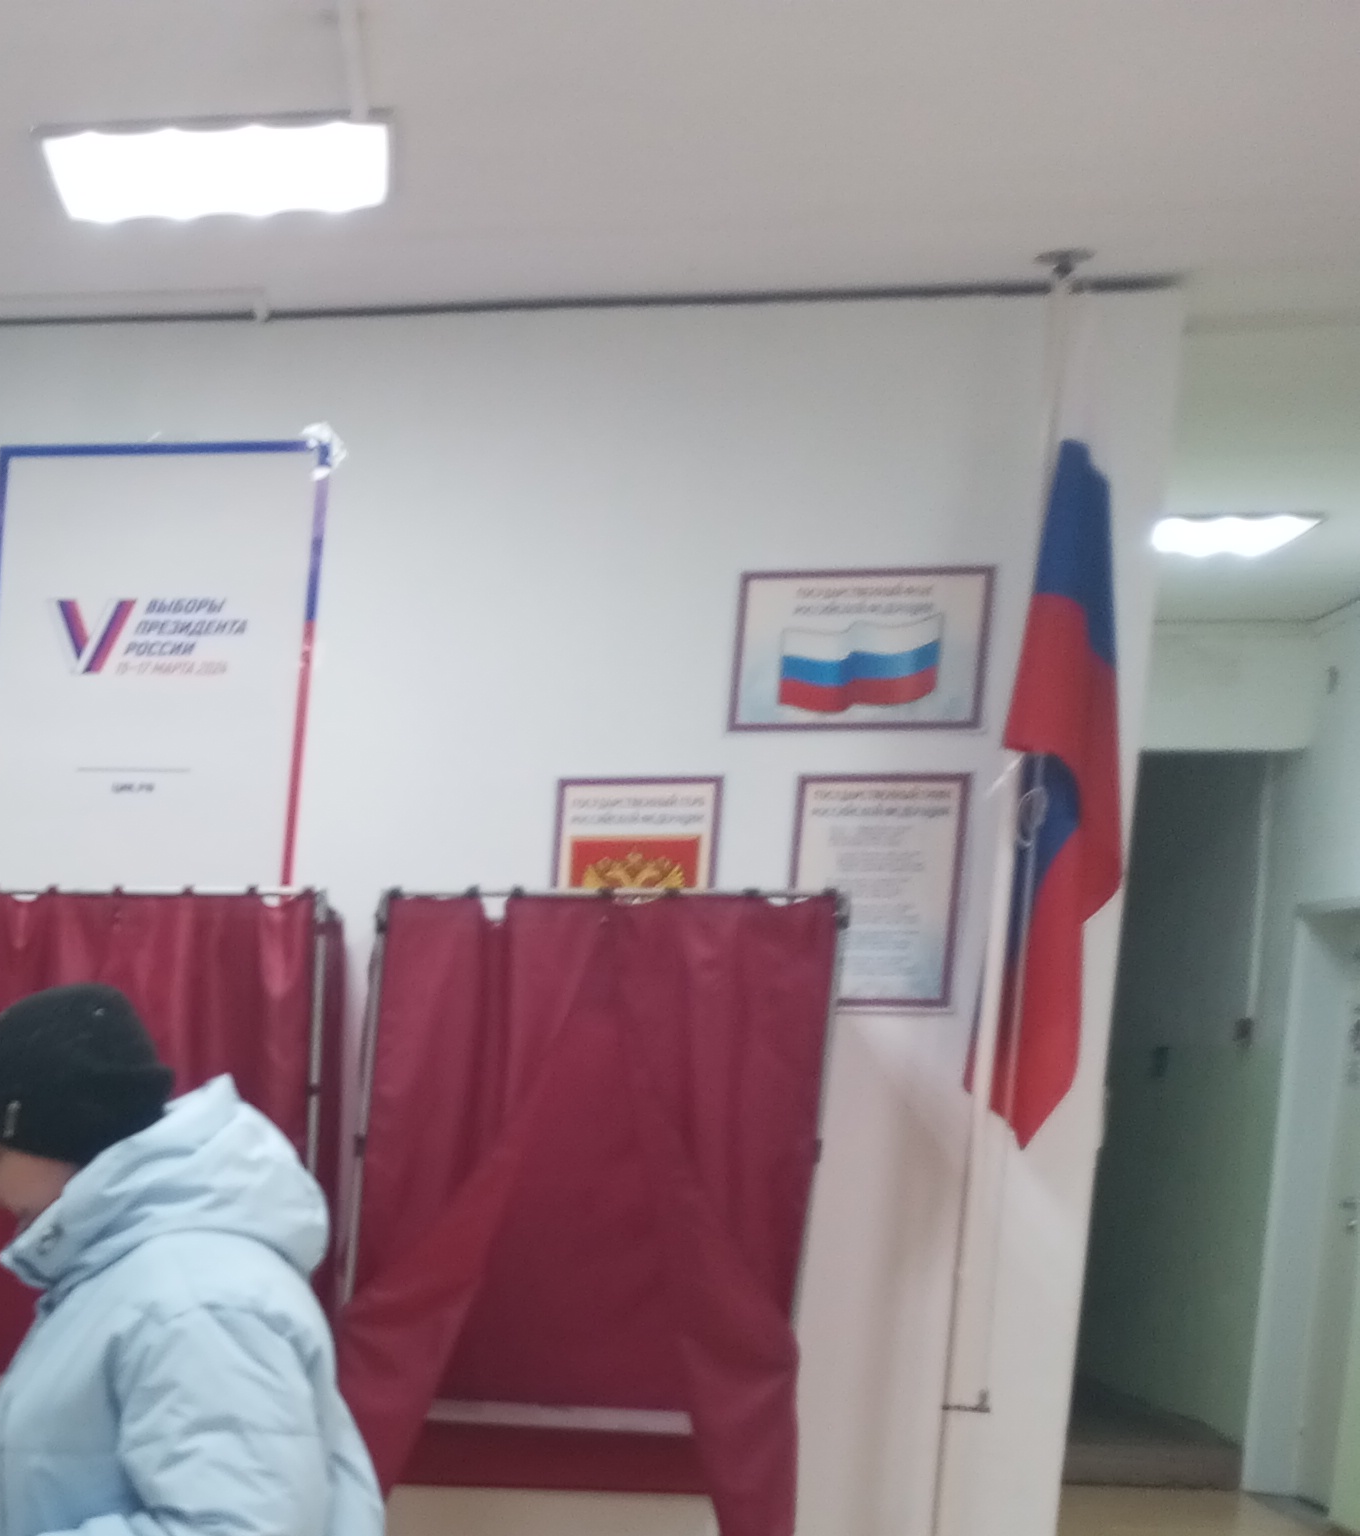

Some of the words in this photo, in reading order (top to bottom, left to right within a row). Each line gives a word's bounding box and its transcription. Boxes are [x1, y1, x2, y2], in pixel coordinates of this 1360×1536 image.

[145, 597, 226, 615] ВЫБОРЫ
[134, 618, 248, 636] ПРЕЗИДЕНТА
[123, 640, 197, 657] РОССИИ
